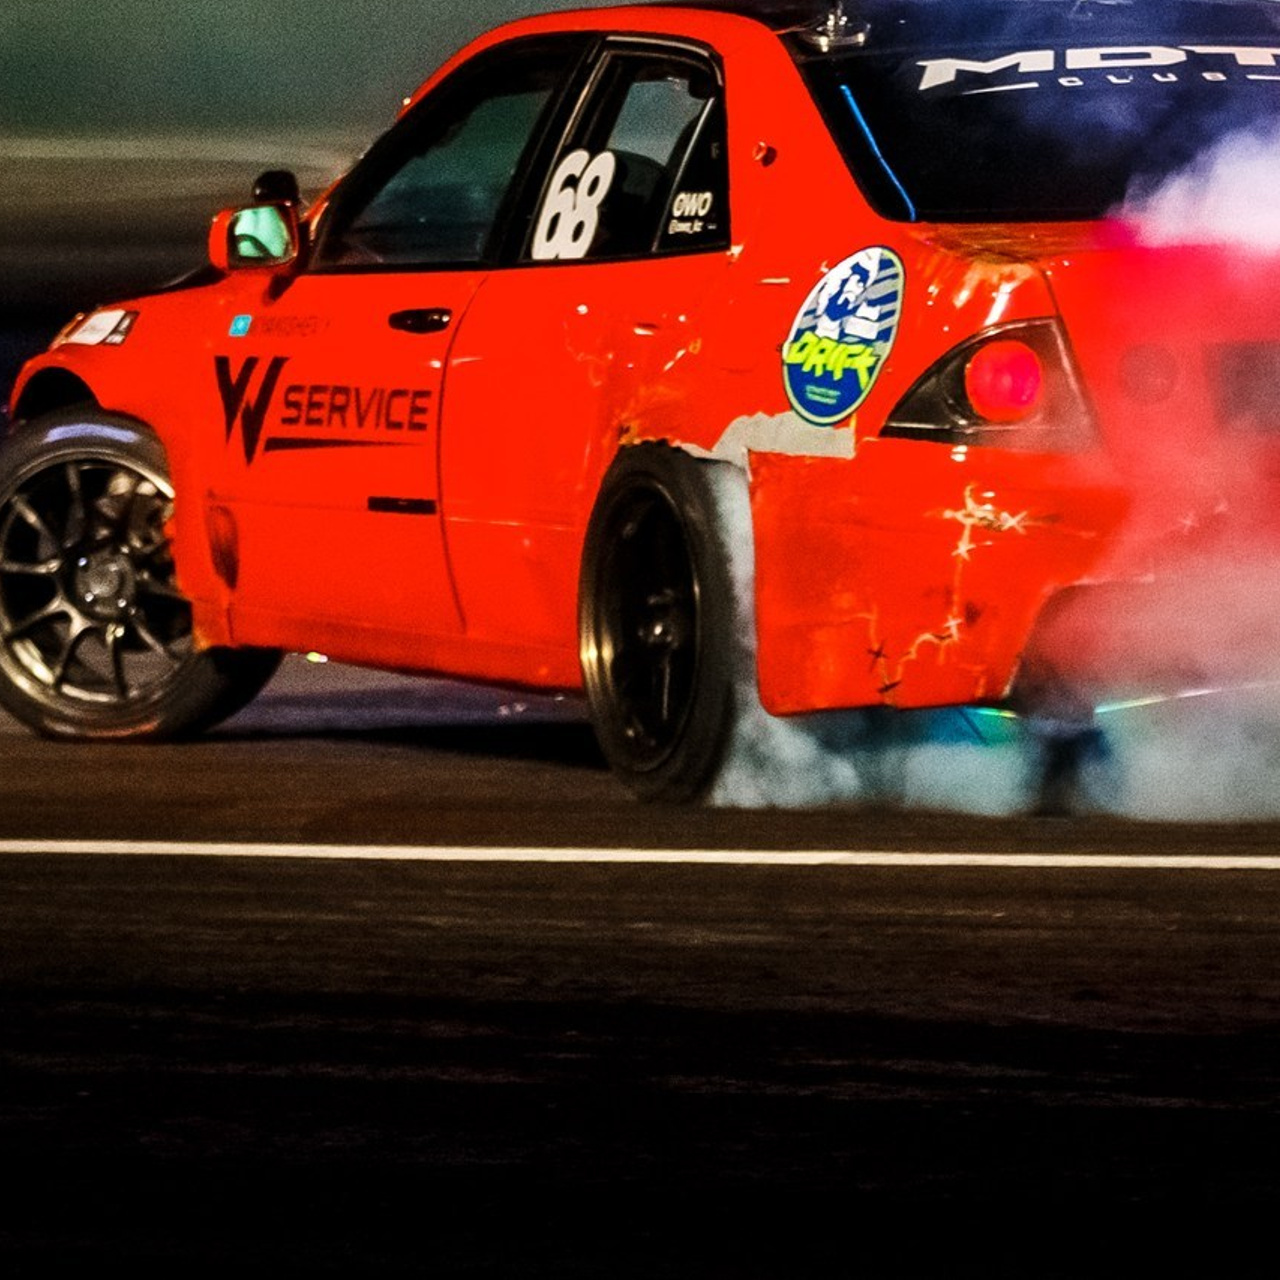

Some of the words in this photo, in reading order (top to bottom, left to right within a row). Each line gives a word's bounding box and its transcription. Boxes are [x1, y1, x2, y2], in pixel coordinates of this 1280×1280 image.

[531, 147, 617, 260] 68
[785, 330, 880, 391] DRIFT
[281, 384, 433, 432] SERVICE
